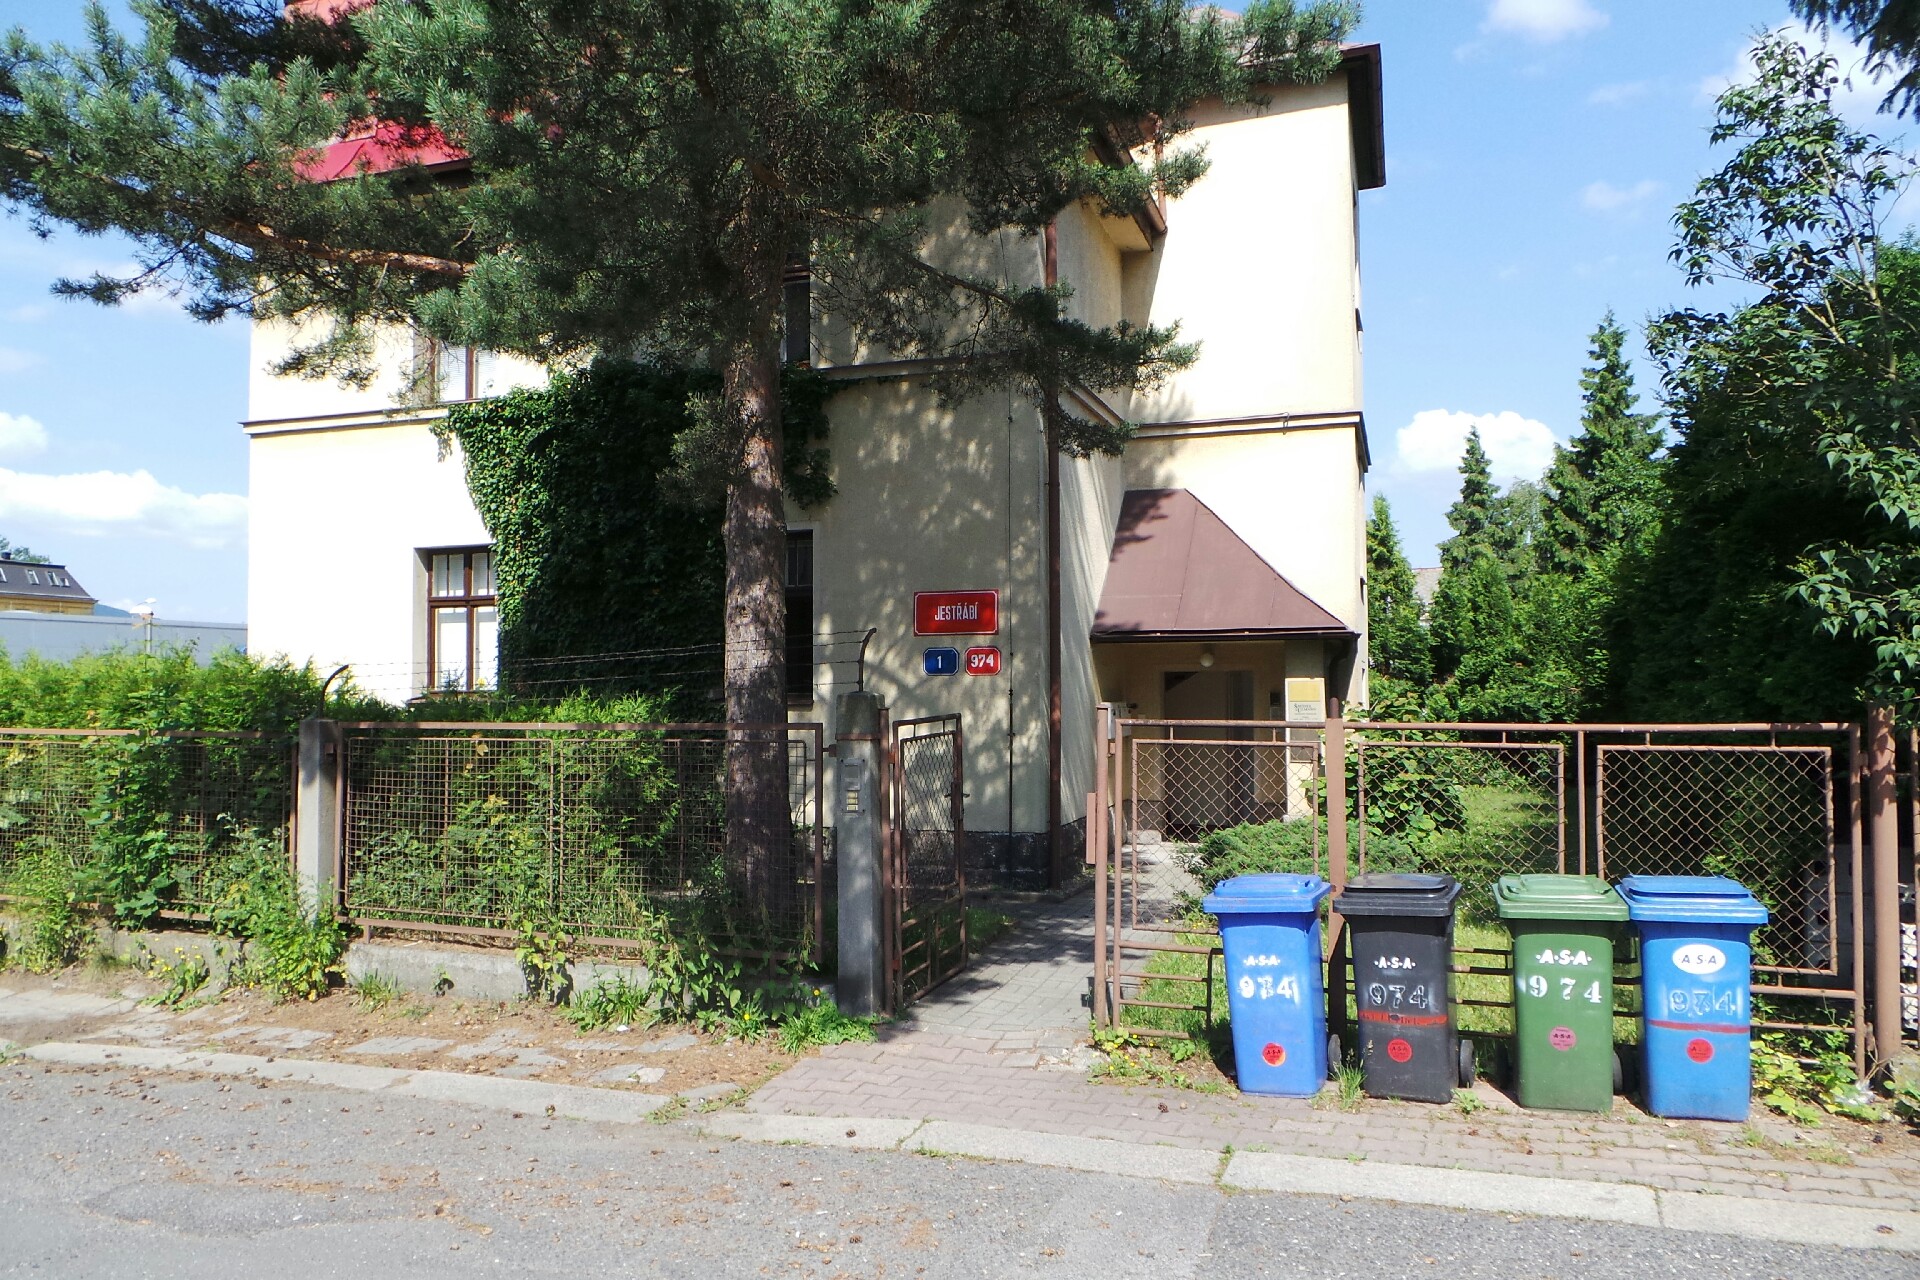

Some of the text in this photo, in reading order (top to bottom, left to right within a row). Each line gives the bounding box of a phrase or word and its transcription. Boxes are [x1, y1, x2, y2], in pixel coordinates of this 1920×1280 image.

[934, 602, 978, 621] JESTŘÁBÍ
[936, 655, 942, 669] 1
[970, 654, 994, 668] 974
[1369, 982, 1428, 1009] 974
[1529, 975, 1602, 1004] 974
[1669, 990, 1736, 1016] 974
